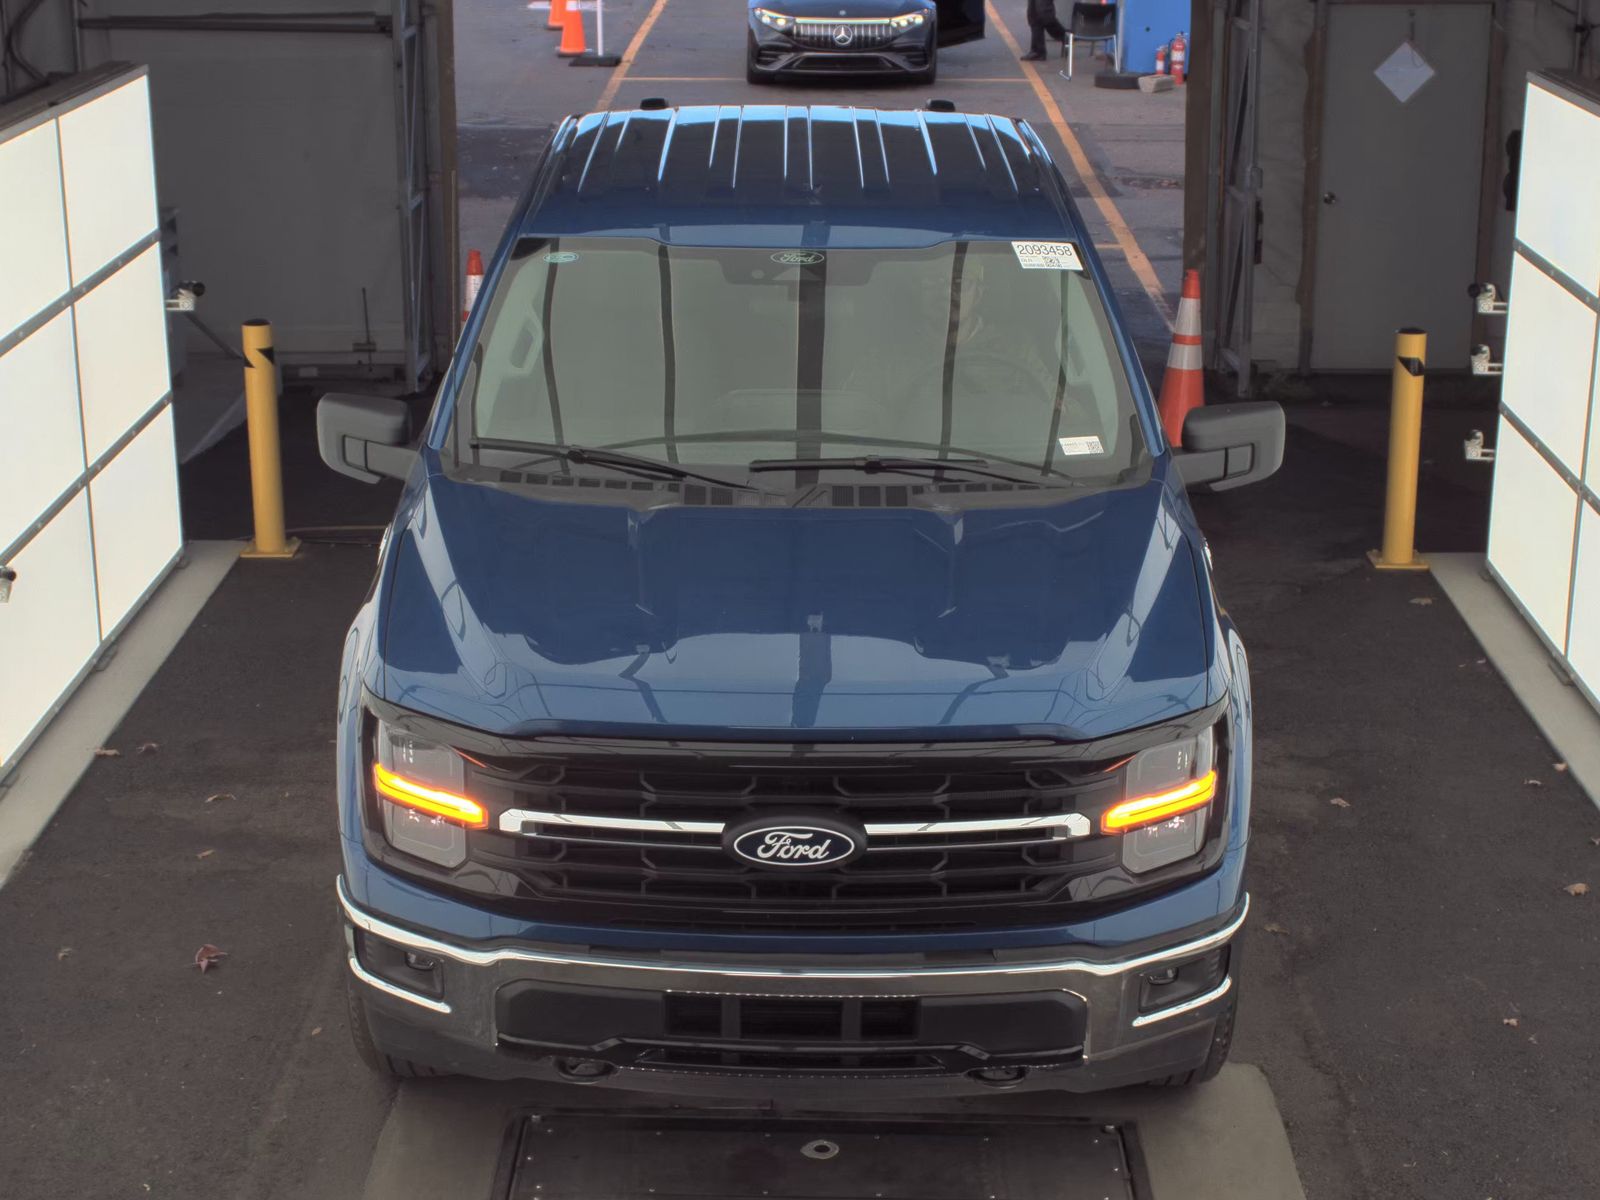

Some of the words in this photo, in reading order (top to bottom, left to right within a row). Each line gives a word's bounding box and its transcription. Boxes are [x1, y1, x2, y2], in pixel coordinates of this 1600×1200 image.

[1017, 245, 1072, 256] 2093458
[781, 252, 815, 262] Ford
[757, 832, 831, 859] Ford
